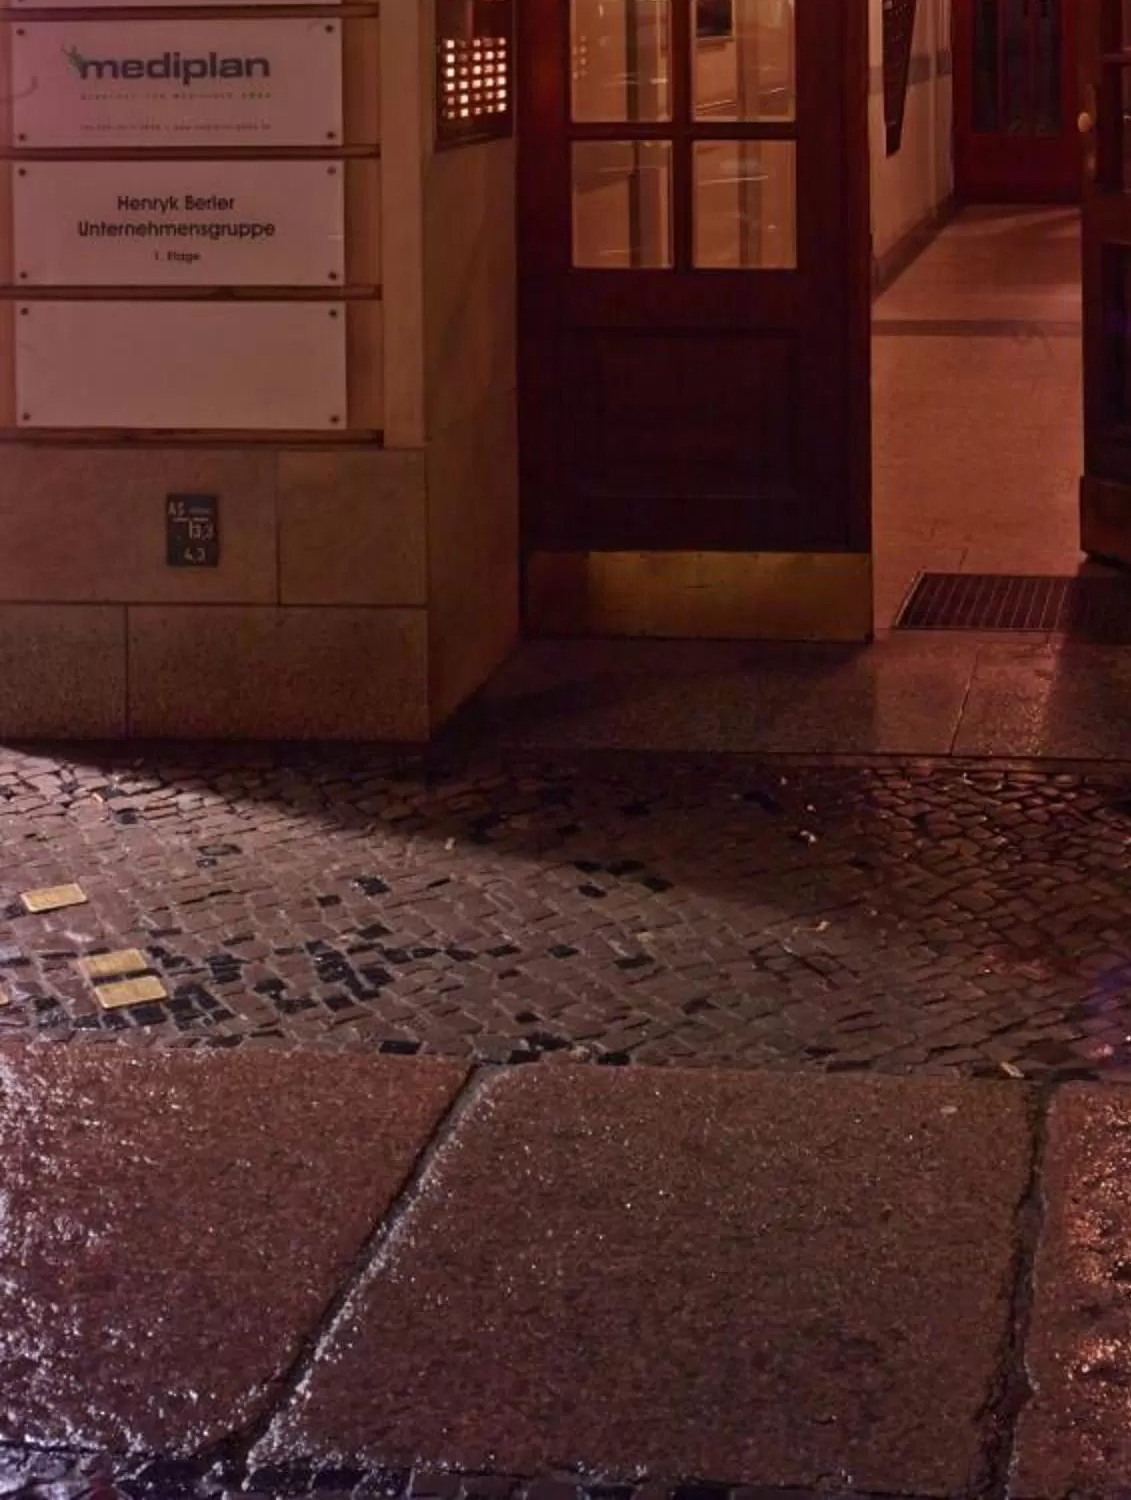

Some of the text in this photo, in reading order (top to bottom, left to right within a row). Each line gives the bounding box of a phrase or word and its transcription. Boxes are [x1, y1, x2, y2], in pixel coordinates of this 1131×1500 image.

[79, 52, 270, 85] mediplan
[117, 195, 179, 213] Henryk
[78, 221, 276, 241] Unternehmensgruppe
